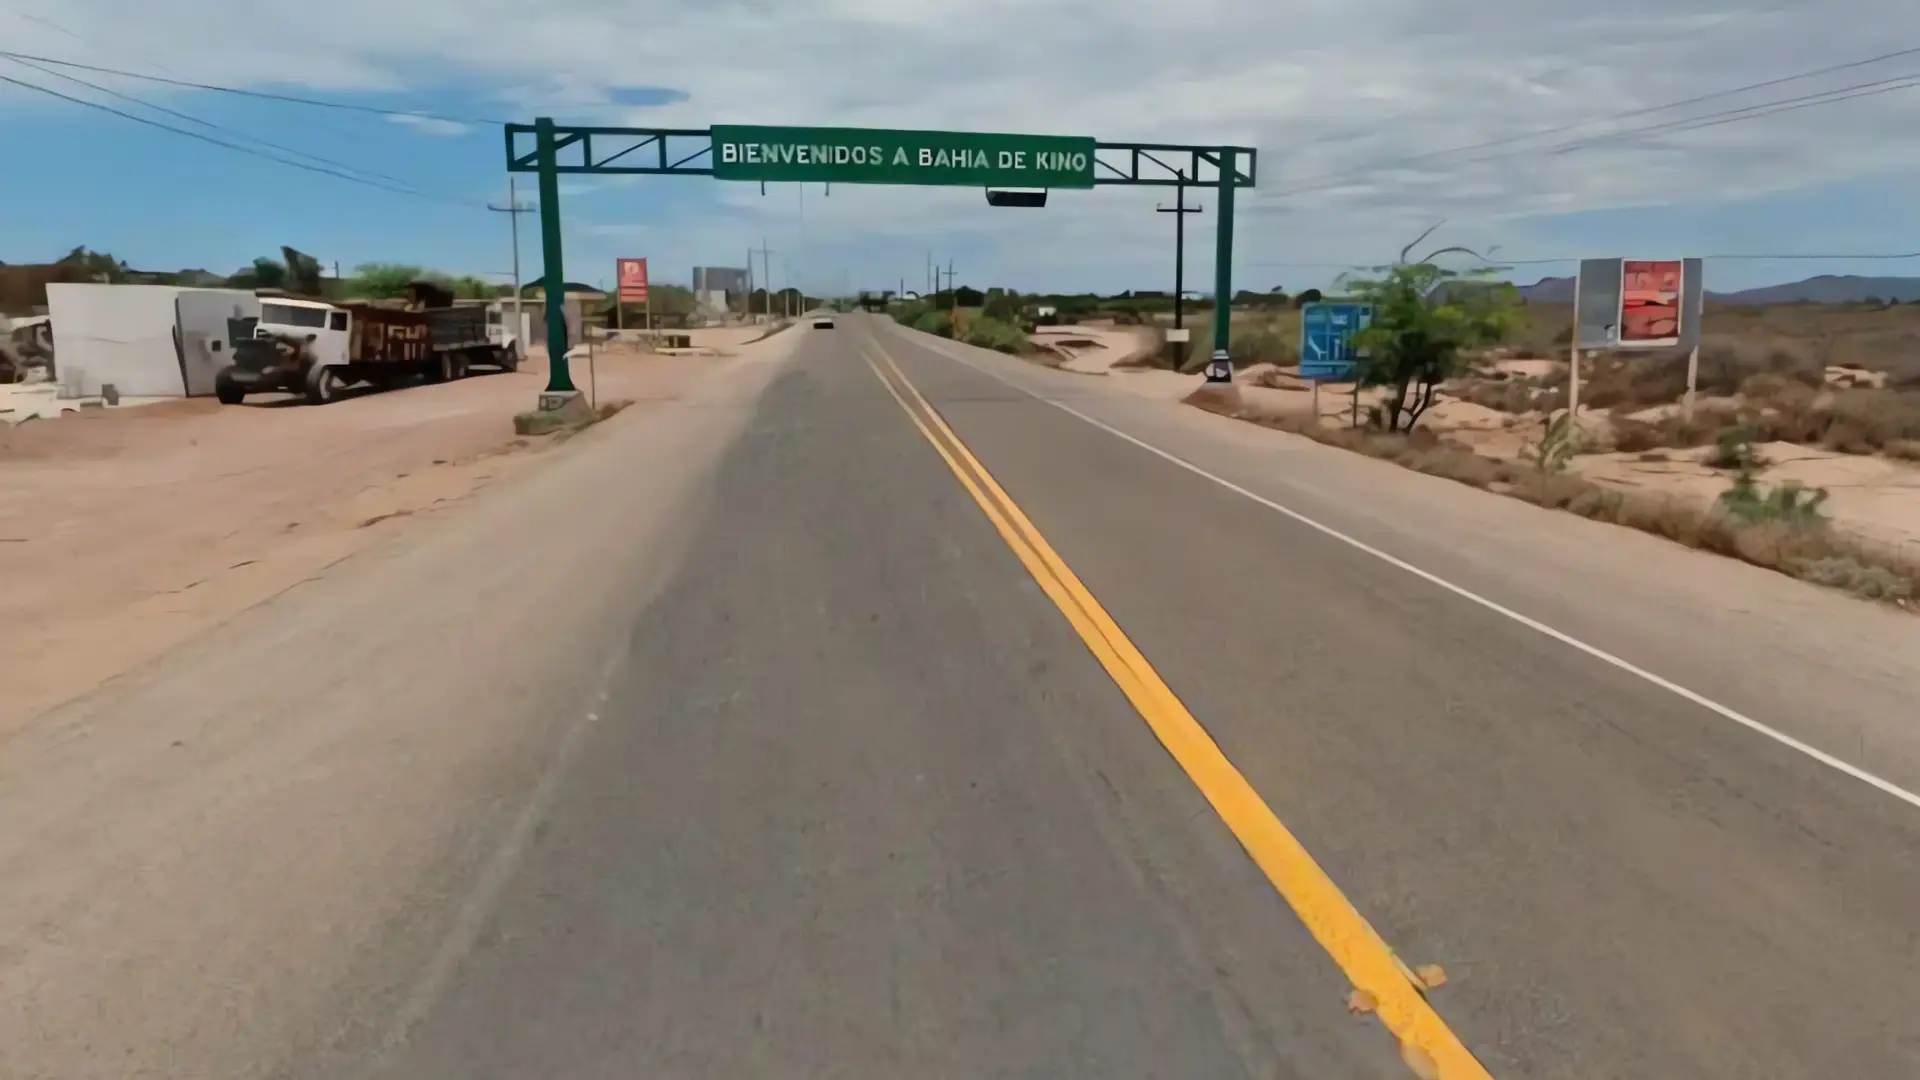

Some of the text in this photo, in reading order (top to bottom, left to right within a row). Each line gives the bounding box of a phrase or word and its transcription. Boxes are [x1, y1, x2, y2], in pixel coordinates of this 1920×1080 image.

[722, 143, 1087, 172] BIENVENIDOS A BAHIA DE KINO
